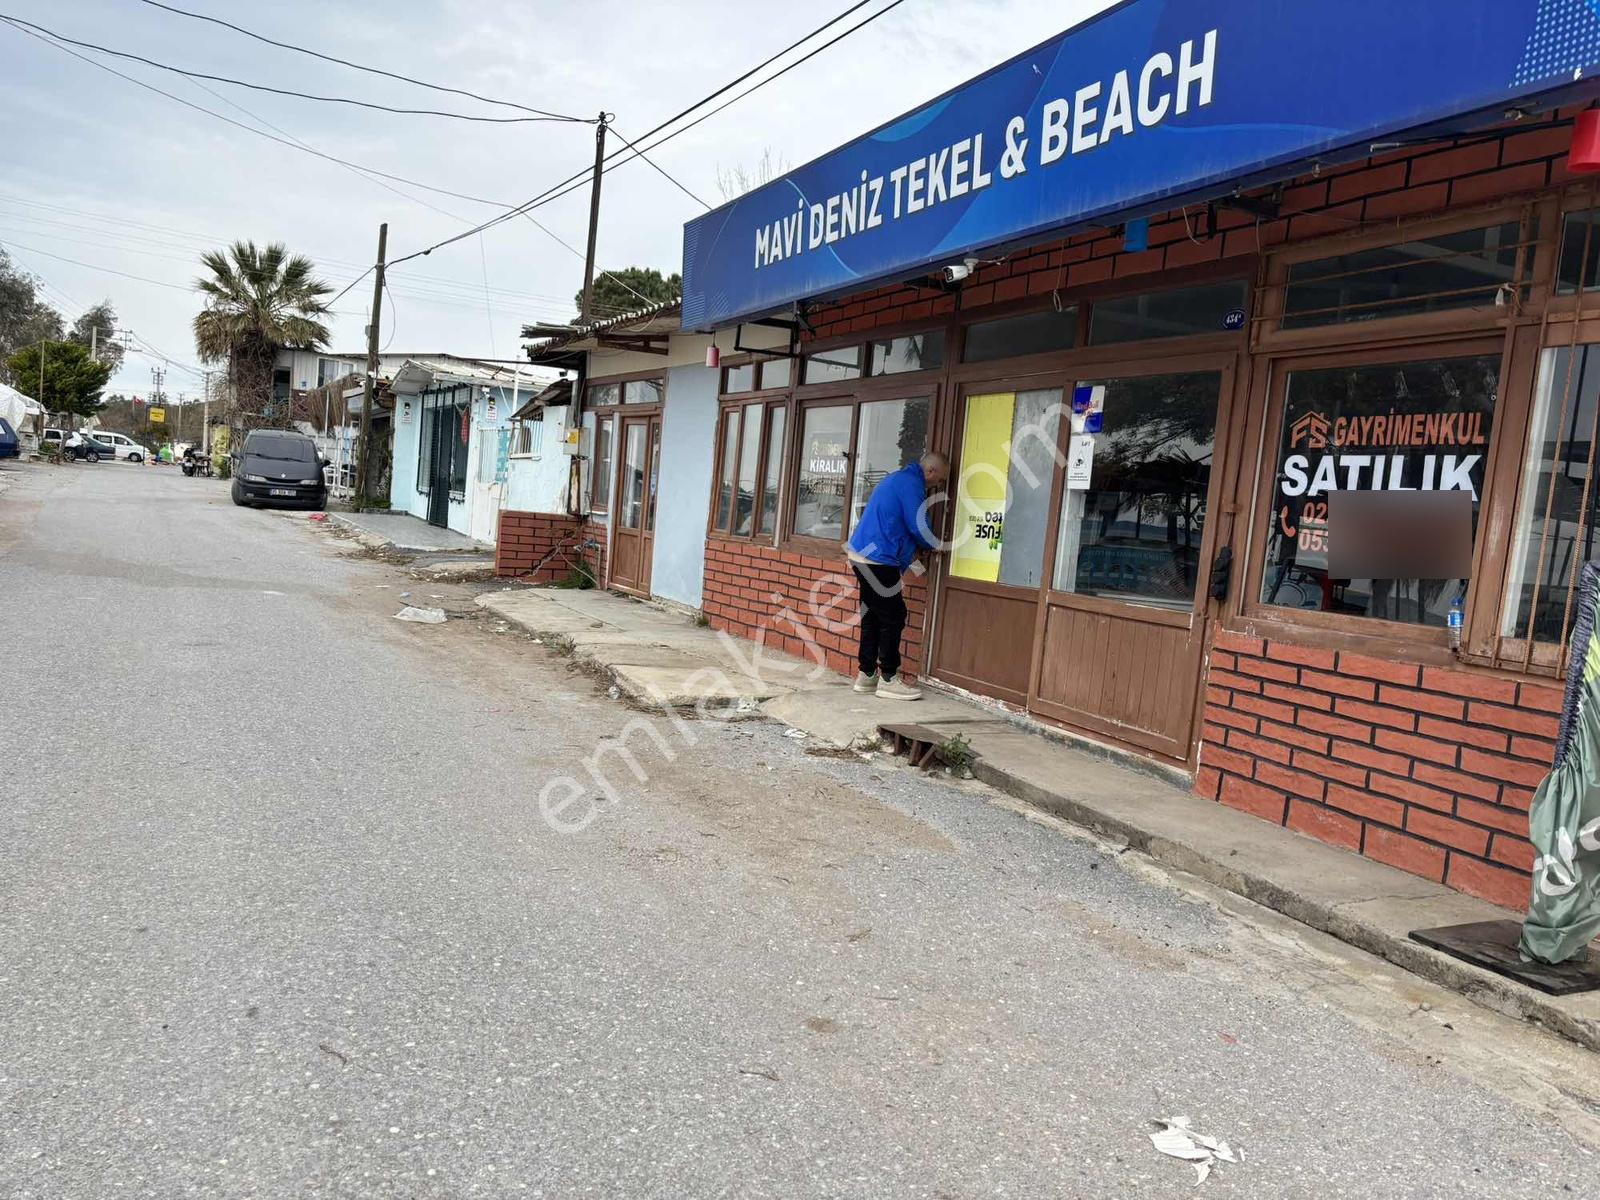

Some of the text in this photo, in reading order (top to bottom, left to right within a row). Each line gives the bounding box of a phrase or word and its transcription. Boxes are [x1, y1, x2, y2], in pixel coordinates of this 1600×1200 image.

[755, 29, 1218, 270] MAVİ DENİZ TEKEL & BEACH
[1333, 407, 1485, 447] GAYRİMENKUL
[809, 456, 847, 473] KİRALIK
[1280, 454, 1483, 502] SATILIK
[985, 511, 1003, 525] tea
[1303, 502, 1328, 525] 02
[975, 524, 1002, 539] FUSE
